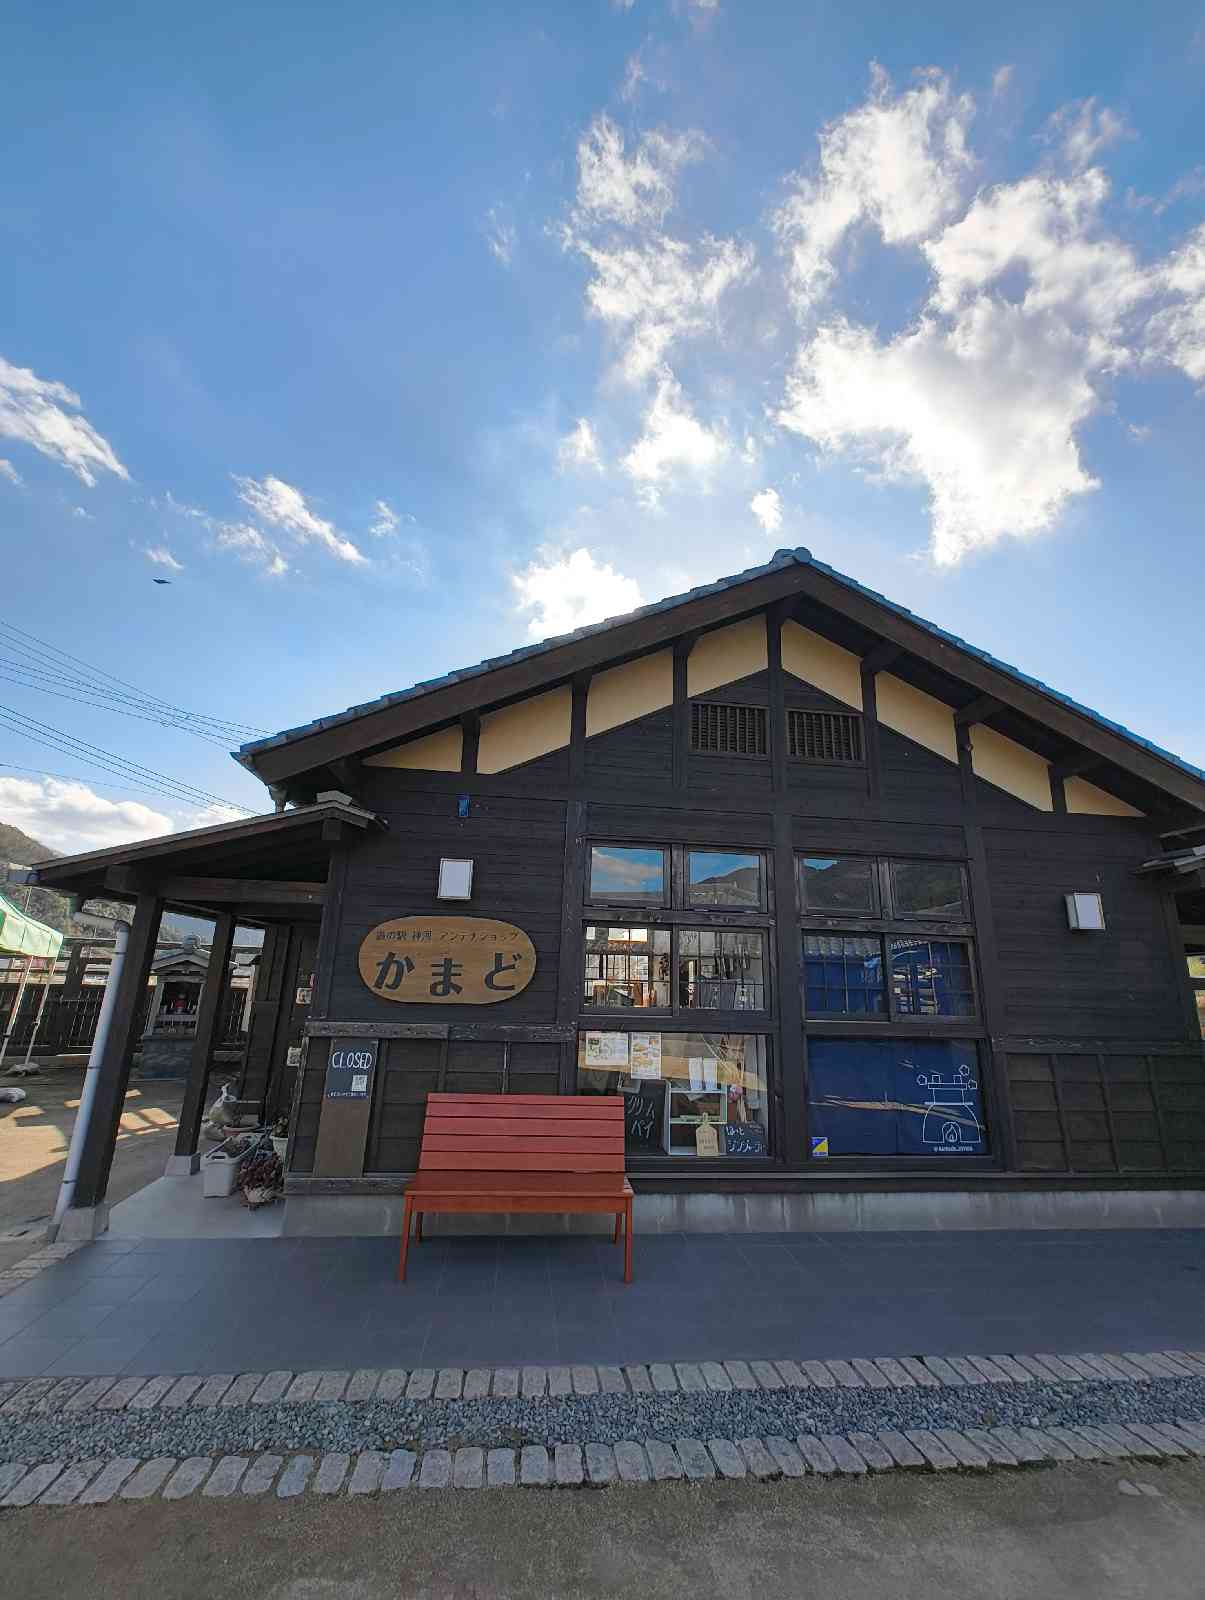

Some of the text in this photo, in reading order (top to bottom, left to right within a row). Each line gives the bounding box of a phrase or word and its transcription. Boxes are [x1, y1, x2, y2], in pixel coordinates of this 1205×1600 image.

[373, 951, 522, 997] かまど
[332, 1051, 372, 1068] CLOSED
